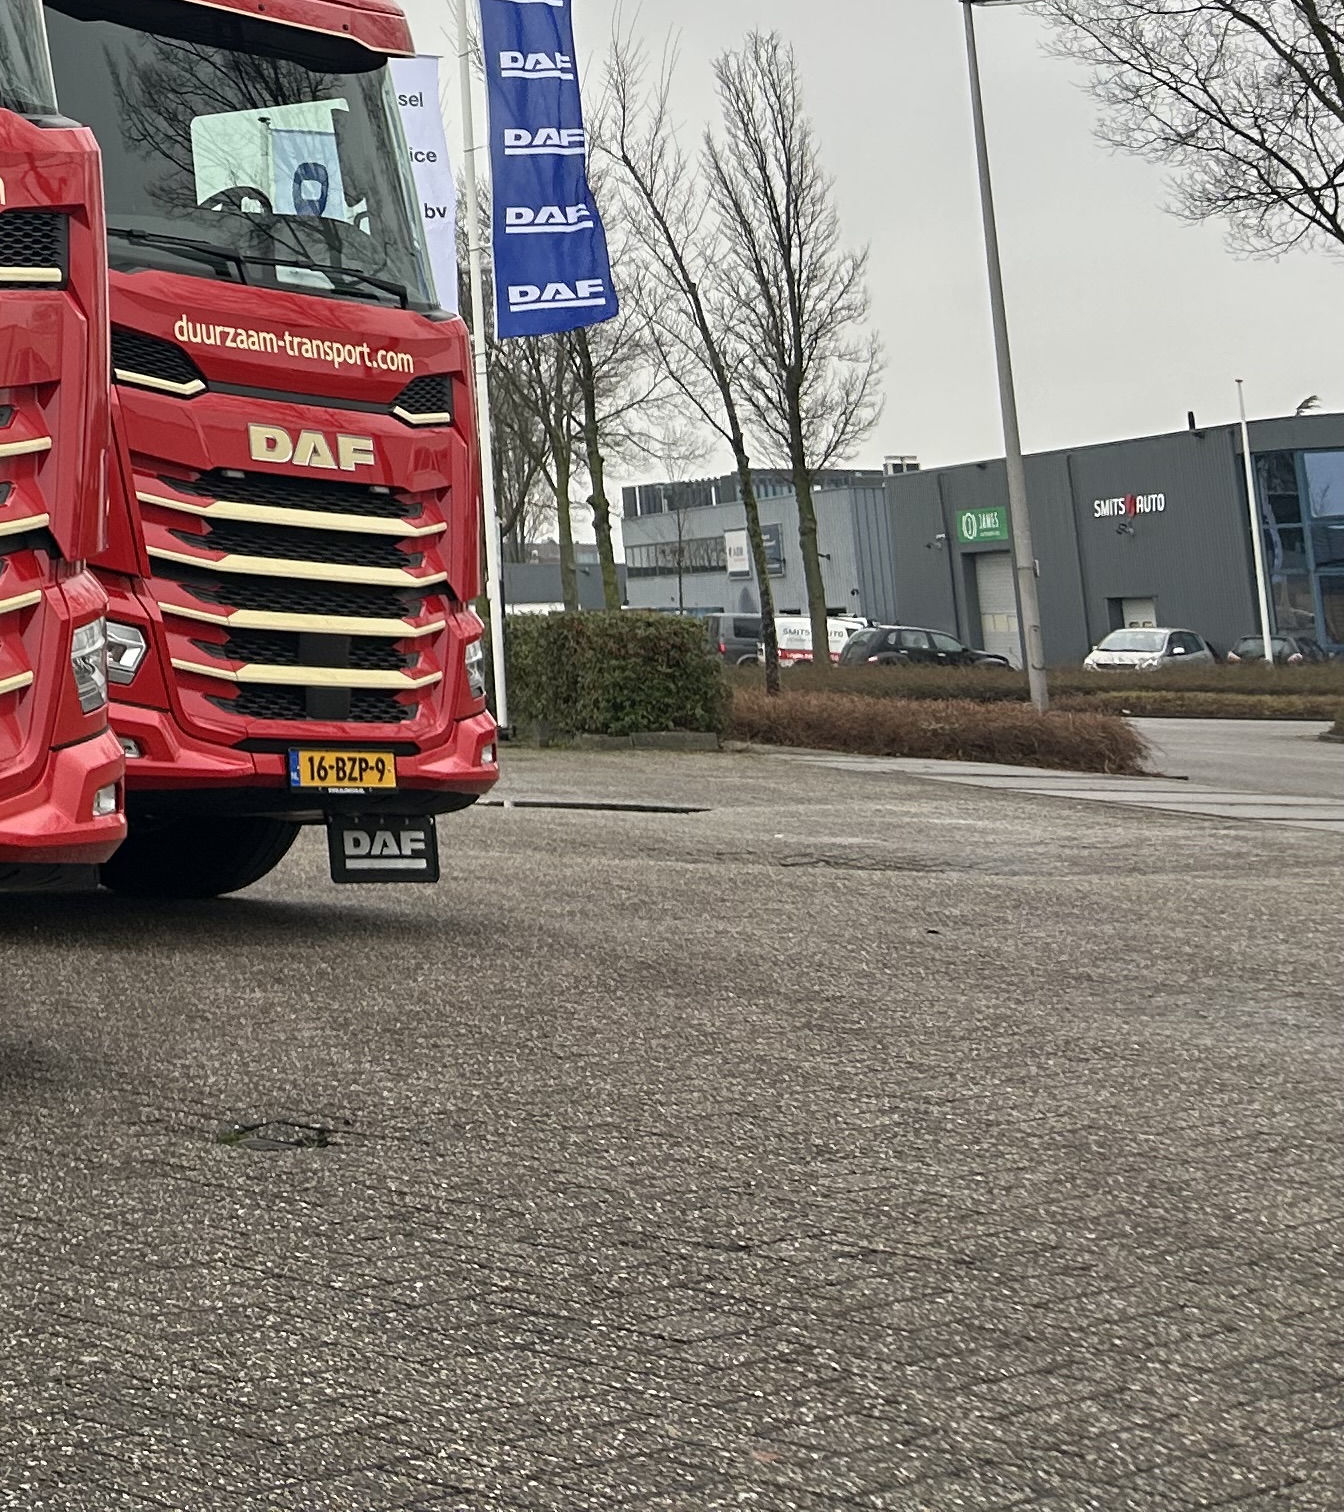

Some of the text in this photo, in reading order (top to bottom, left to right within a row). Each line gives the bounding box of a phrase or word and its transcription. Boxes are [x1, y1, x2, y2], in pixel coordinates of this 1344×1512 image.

[499, 51, 572, 70] DAF
[398, 92, 424, 108] sel
[504, 128, 585, 147] DAF
[424, 203, 447, 219] bv
[505, 203, 590, 225] DAF
[508, 278, 604, 304] DAF
[174, 314, 414, 373] duurzaam-transport.com
[247, 422, 375, 472] DAF
[1094, 493, 1165, 518] SMITS AUTO
[308, 756, 386, 782] 16-BZP-9
[342, 829, 426, 855] DAF
